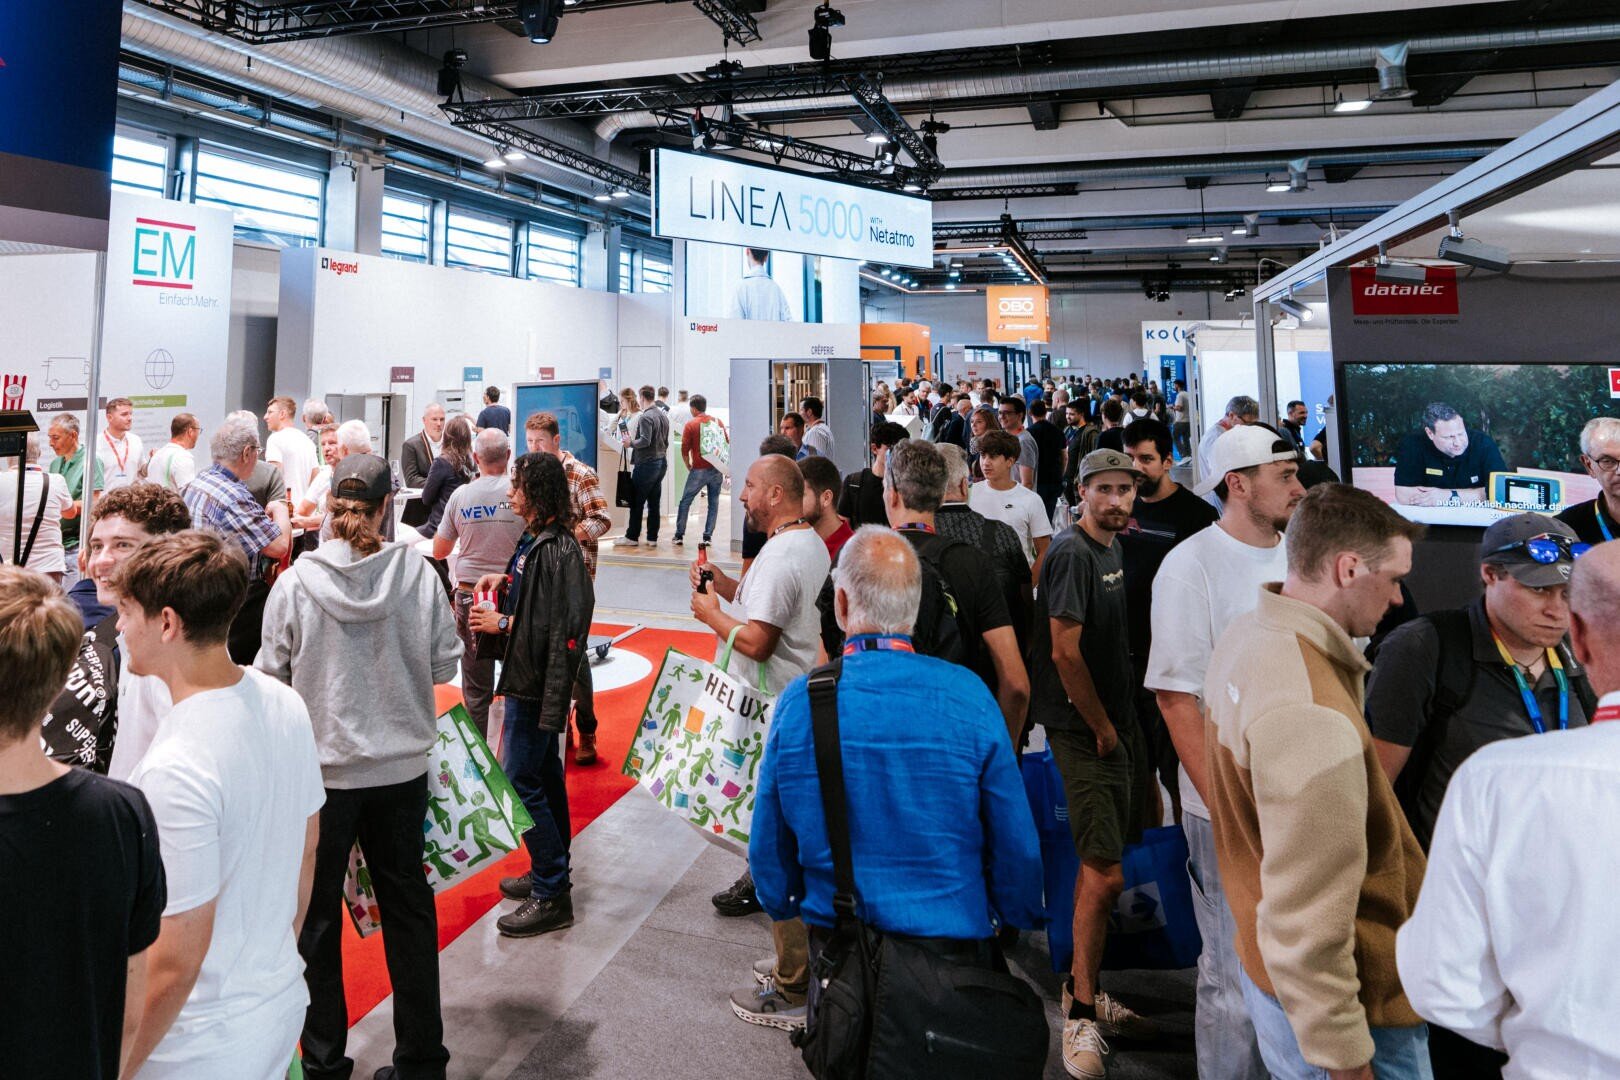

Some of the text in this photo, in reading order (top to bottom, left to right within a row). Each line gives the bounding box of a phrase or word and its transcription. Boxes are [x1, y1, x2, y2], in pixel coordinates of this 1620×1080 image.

[690, 176, 863, 242] LINEA 5000
[870, 216, 883, 224] WITH
[870, 226, 915, 247] Netatmo
[133, 228, 195, 280] EM
[330, 258, 358, 275] legrand
[999, 301, 1034, 312] OBO
[696, 323, 718, 334] legrand
[811, 344, 834, 355] CRÊPERIE
[39, 401, 64, 410] Logistik
[1463, 499, 1502, 509] wirklich
[461, 505, 497, 519] WEW
